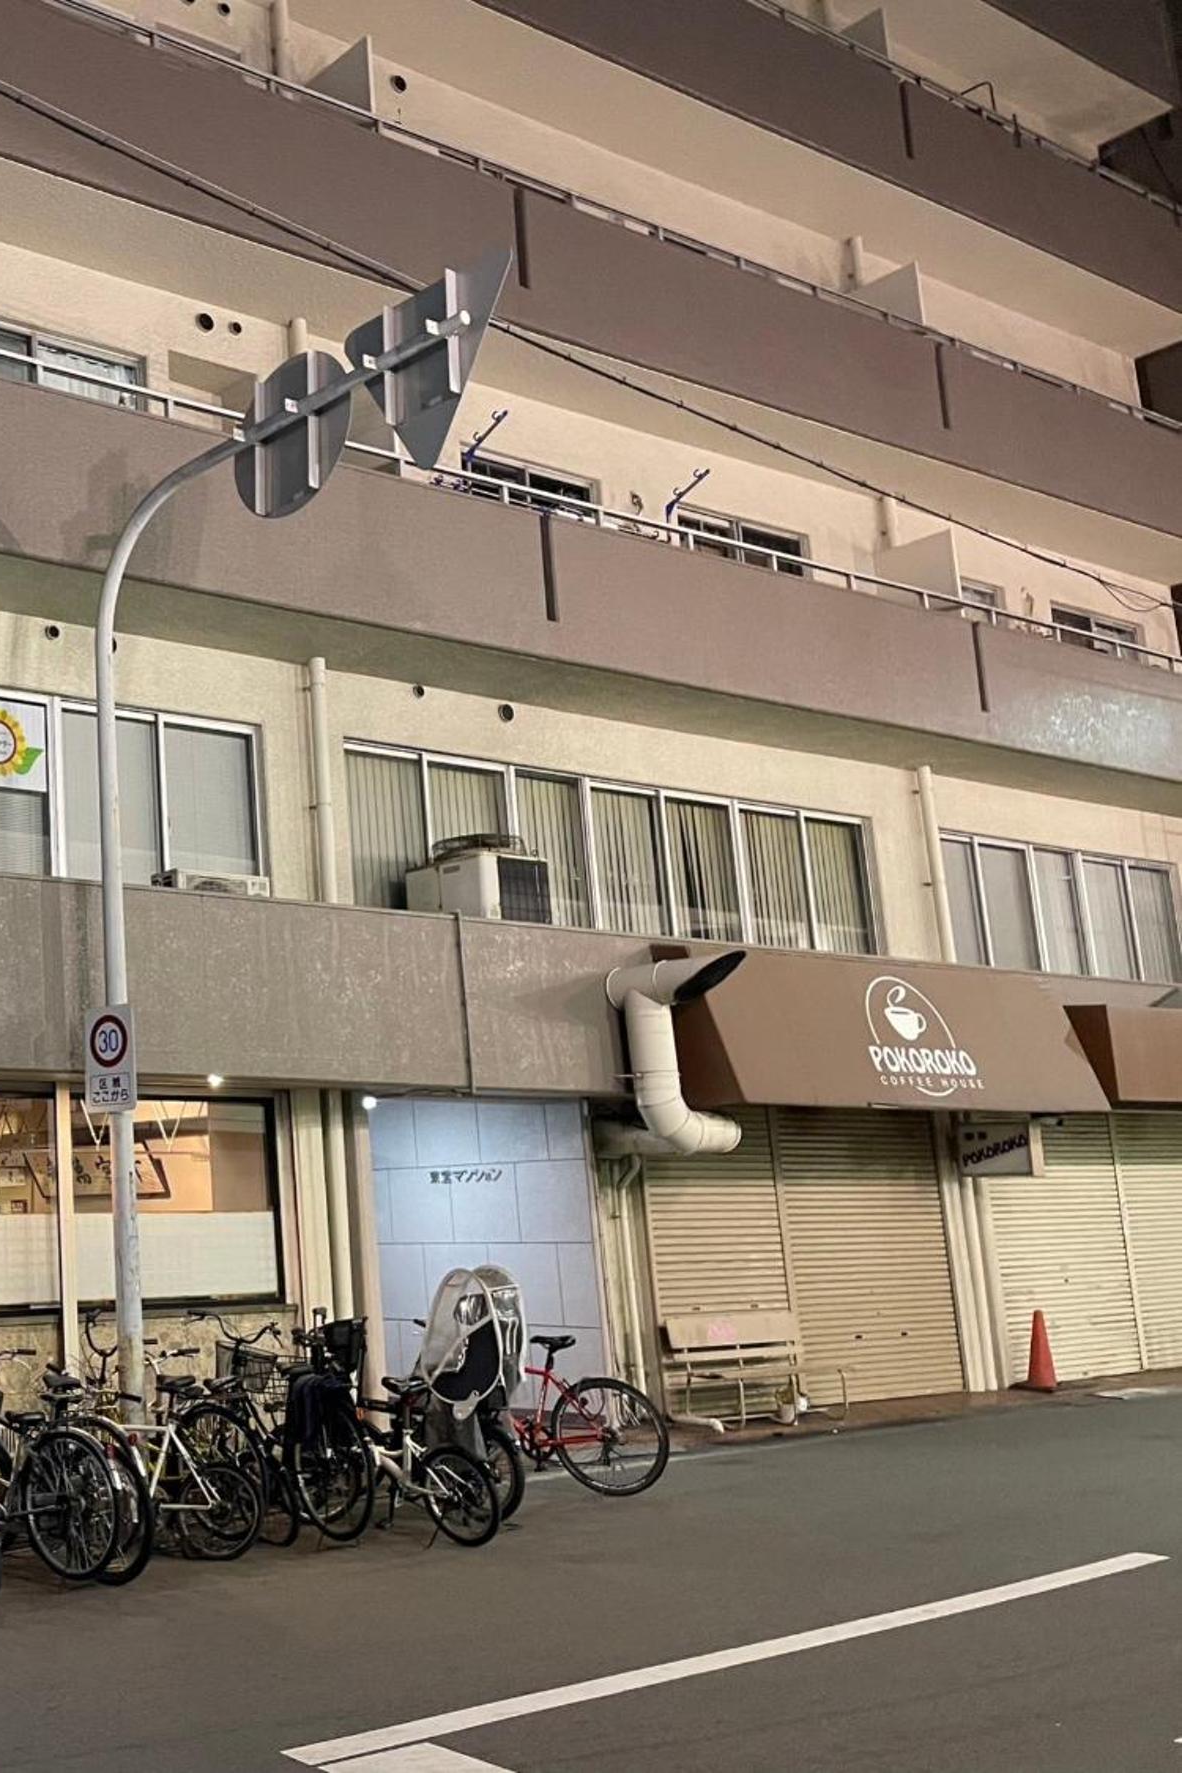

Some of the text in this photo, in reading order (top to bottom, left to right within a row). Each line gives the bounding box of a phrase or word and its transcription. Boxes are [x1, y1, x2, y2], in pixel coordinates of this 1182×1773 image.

[98, 1029, 119, 1053] 30
[868, 1045, 977, 1076] POKOROKO
[880, 1075, 986, 1090] COFFEE HOUSE
[92, 1088, 129, 1104] ここから
